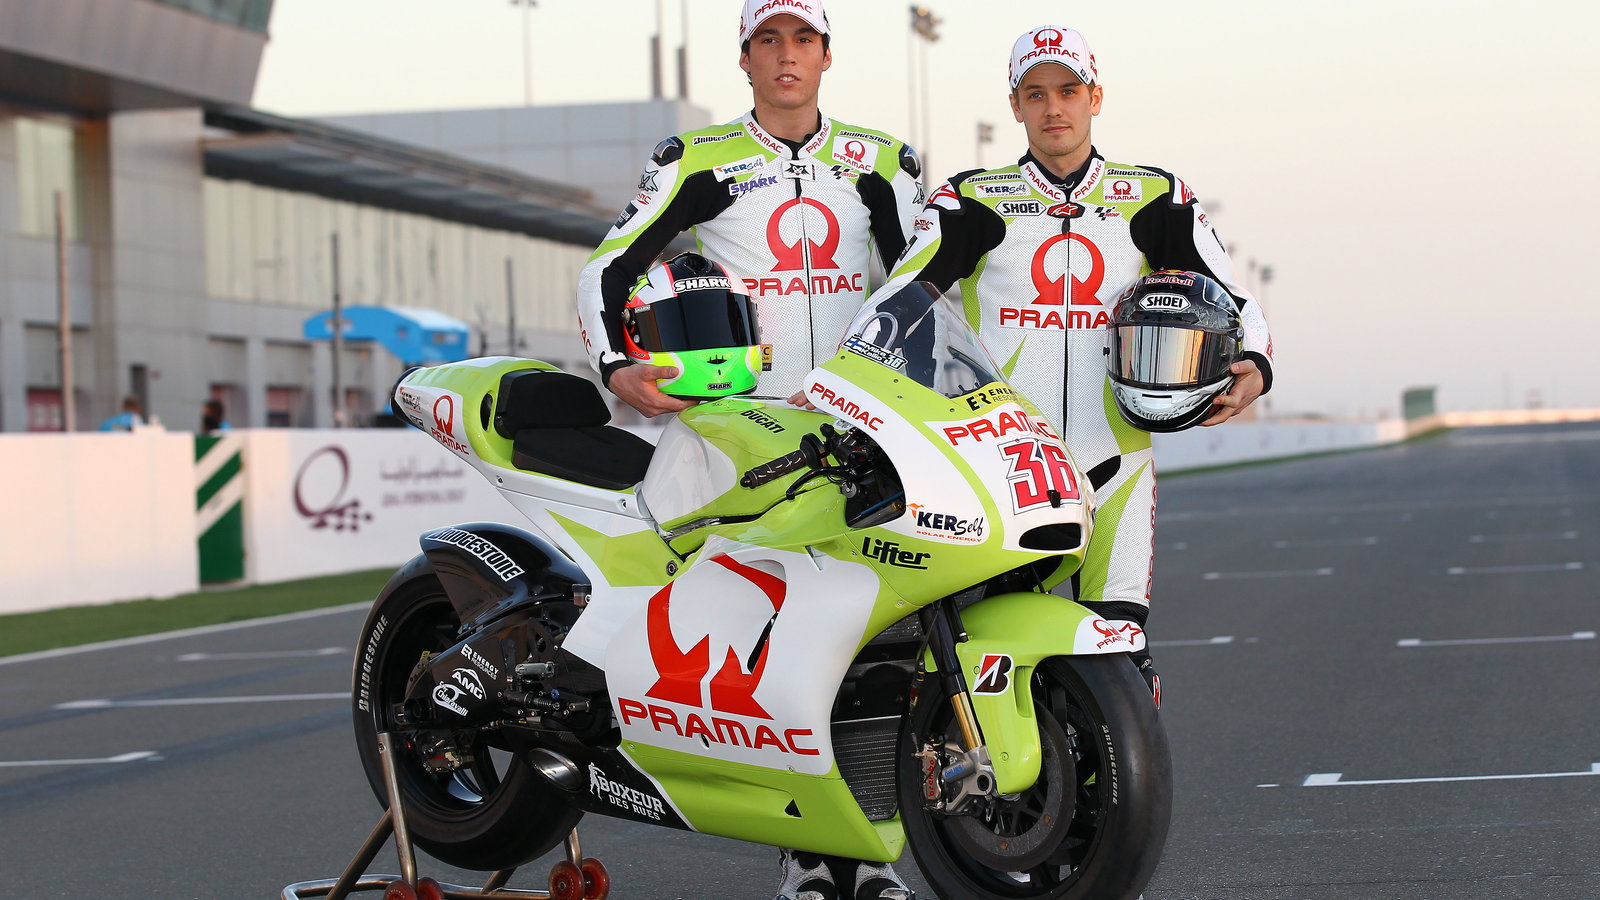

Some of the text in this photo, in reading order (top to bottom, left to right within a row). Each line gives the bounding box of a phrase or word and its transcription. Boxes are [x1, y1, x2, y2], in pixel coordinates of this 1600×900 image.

[754, 0, 812, 20] PRAMAC
[1020, 47, 1080, 66] PRAMAC
[693, 131, 743, 145] BRIDGESTONE
[746, 121, 784, 153] PRAMAC
[805, 123, 830, 154] PRAMAC
[839, 131, 893, 147] BRIDGESTONE
[833, 152, 872, 172] PRAMAC
[1107, 168, 1161, 178] BRIDGESTONE
[730, 175, 778, 194] SHARK
[967, 174, 1022, 183] BRIDGESTONE
[1025, 165, 1062, 200] PRAMAC
[1074, 161, 1102, 199] PRAMAC
[1002, 202, 1040, 214] SHOEI
[674, 277, 731, 293] SHARK
[742, 272, 864, 297] PRAMAC
[1145, 276, 1194, 287] Red Bull
[1146, 296, 1184, 308] SHOEI
[1000, 307, 1109, 329] PRAMA
[884, 354, 904, 368] 36
[708, 382, 731, 390] SHARK
[811, 382, 884, 432] PRAMAC
[740, 410, 786, 434] DUCATI
[943, 410, 1060, 447] PRAMAC
[431, 427, 470, 455] PRAMAC
[1000, 438, 1082, 514] 36
[916, 511, 984, 537] KERSelf
[916, 530, 983, 543] SOLAR ENERGY
[425, 527, 525, 582] BRIDGESTONE
[862, 536, 931, 570] Lifter
[359, 614, 389, 713] BRIDGESTONE
[471, 657, 498, 680] RESOURCES
[472, 651, 499, 675] ENERGY
[618, 697, 820, 756] PRAMAC
[1101, 724, 1118, 805] BRIDGESTONE
[927, 759, 935, 798] brembo
[597, 775, 666, 815] BOXEUR
[608, 794, 661, 821] DES RUES
